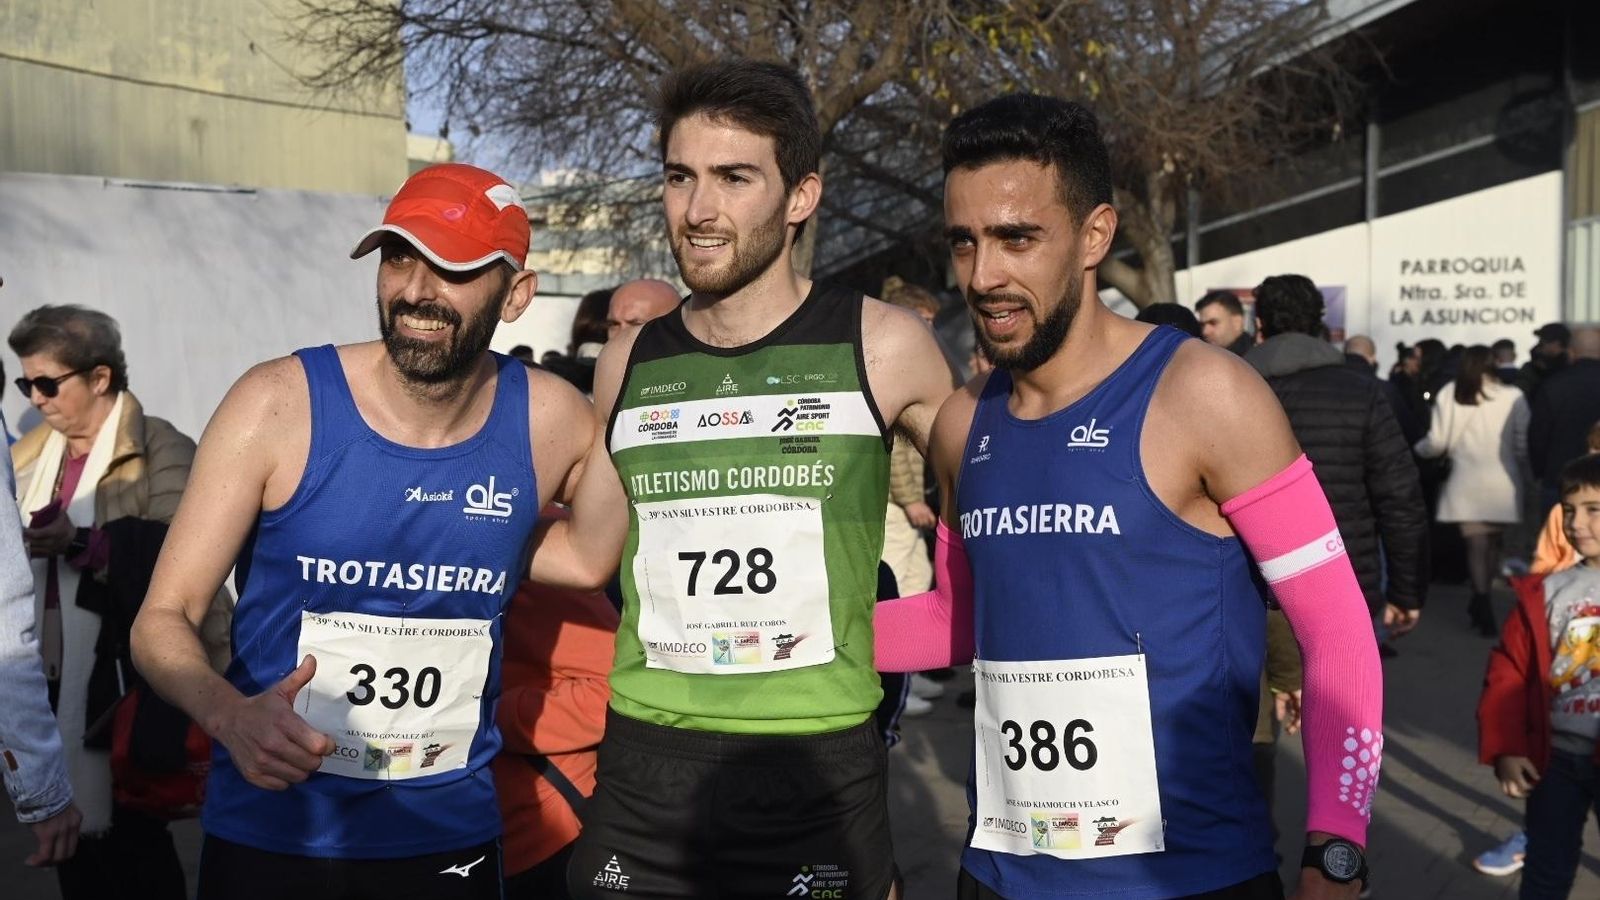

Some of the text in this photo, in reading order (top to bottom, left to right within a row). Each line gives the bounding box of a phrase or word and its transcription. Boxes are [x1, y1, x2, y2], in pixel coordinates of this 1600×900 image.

[1400, 256, 1525, 274] PARROQUIA
[1400, 282, 1526, 300] Ntra. Sra. DE
[1390, 308, 1535, 325] LA ASUNCION
[650, 381, 687, 394] IMDECO
[795, 412, 830, 421] AIRE SPORT
[638, 421, 678, 433] CÓRDOBA
[631, 460, 835, 498] ATLETISMO CORDOBÉS
[680, 504, 738, 518] SILVESTRE
[740, 501, 812, 515] CORDOBESA
[960, 504, 1121, 540] TROTASIERRA
[296, 555, 507, 596] TROTASIERRA
[678, 547, 777, 597] 728
[333, 619, 356, 631] SAN
[357, 623, 419, 637] SILVESTRE
[421, 627, 484, 638] CORDOBESA
[660, 641, 707, 654] IMDECO
[998, 671, 1053, 684] SILVESTRE
[1055, 667, 1136, 683] CORDOBESA
[346, 663, 442, 710] 330
[1001, 718, 1098, 772] 386
[1077, 798, 1119, 809] VELASCO
[594, 871, 630, 887] AIRE
